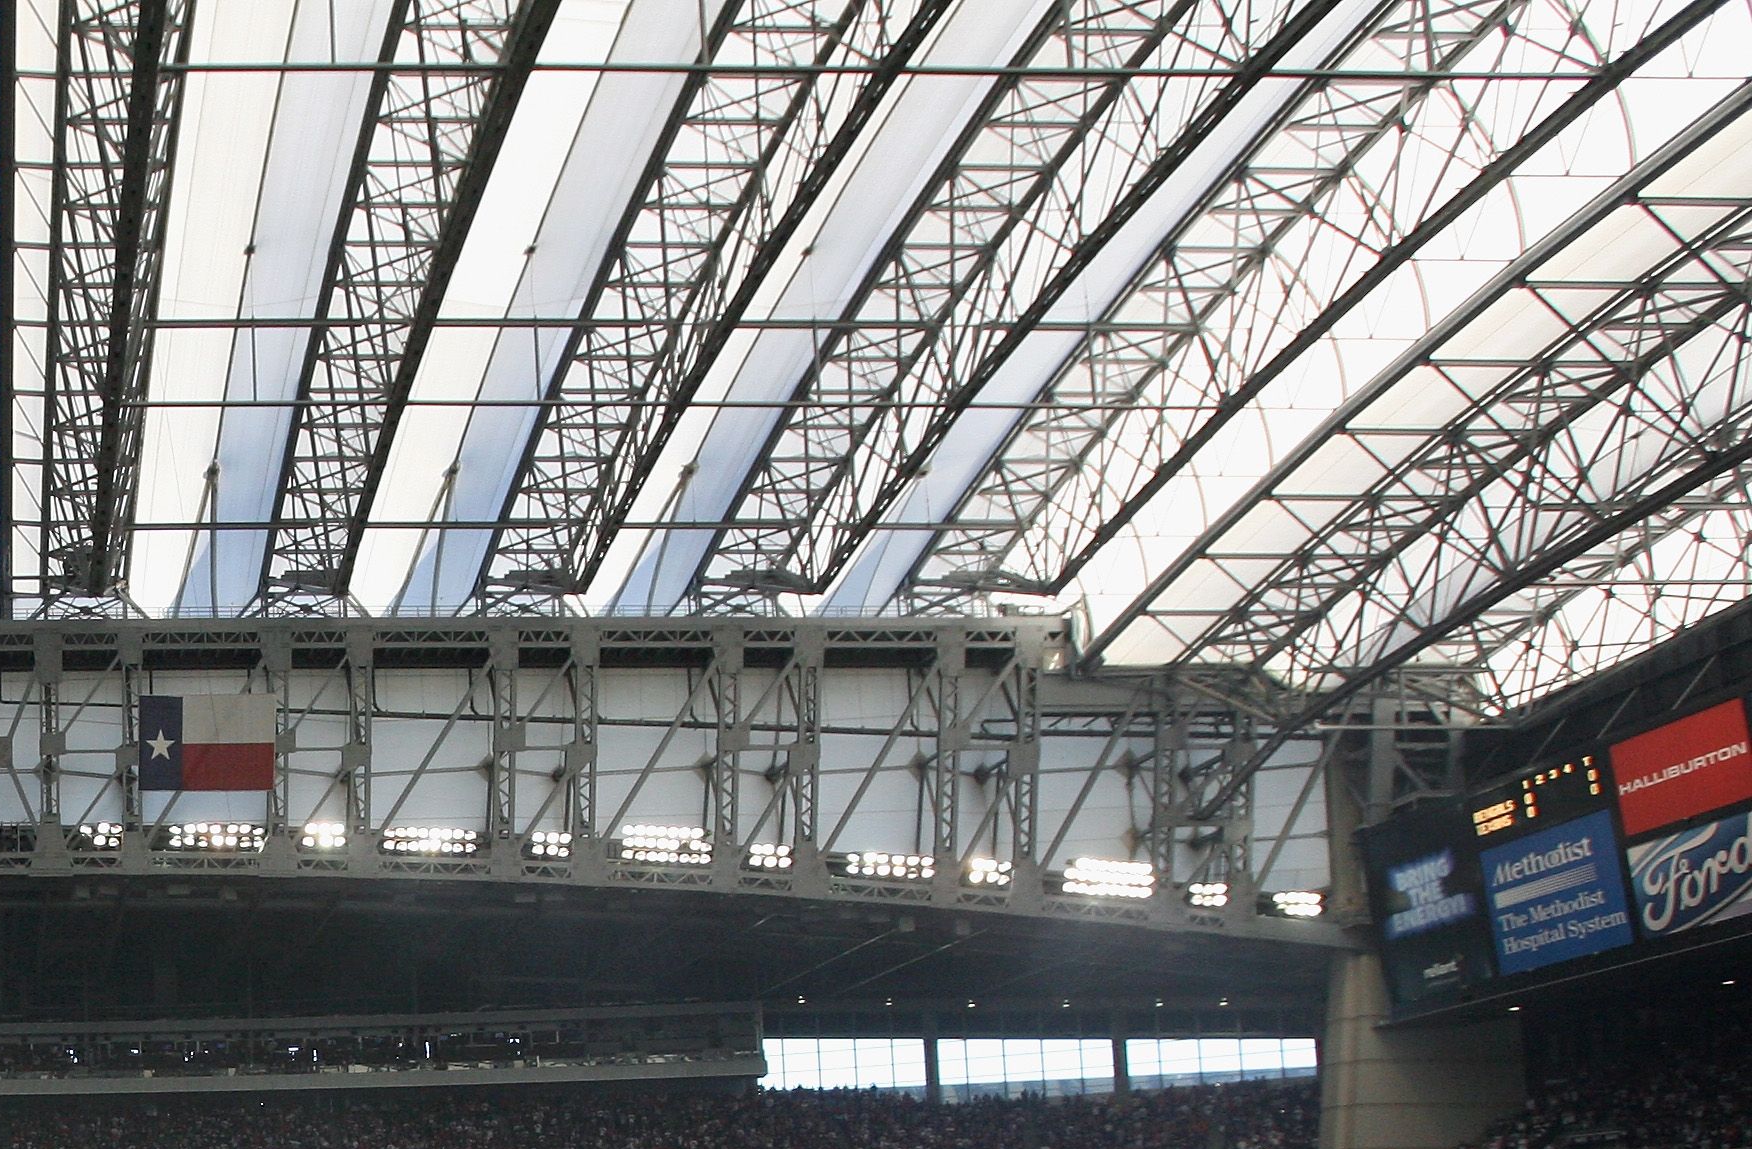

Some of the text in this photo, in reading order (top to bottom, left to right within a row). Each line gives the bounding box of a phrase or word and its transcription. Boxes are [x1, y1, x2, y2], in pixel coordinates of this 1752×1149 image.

[1619, 741, 1748, 796] HALLIBURTON
[1492, 836, 1594, 887] Methodist
[1643, 811, 1752, 932] Ford
[1500, 890, 1606, 933] The Methodist
[1502, 911, 1627, 955] Hospital System
